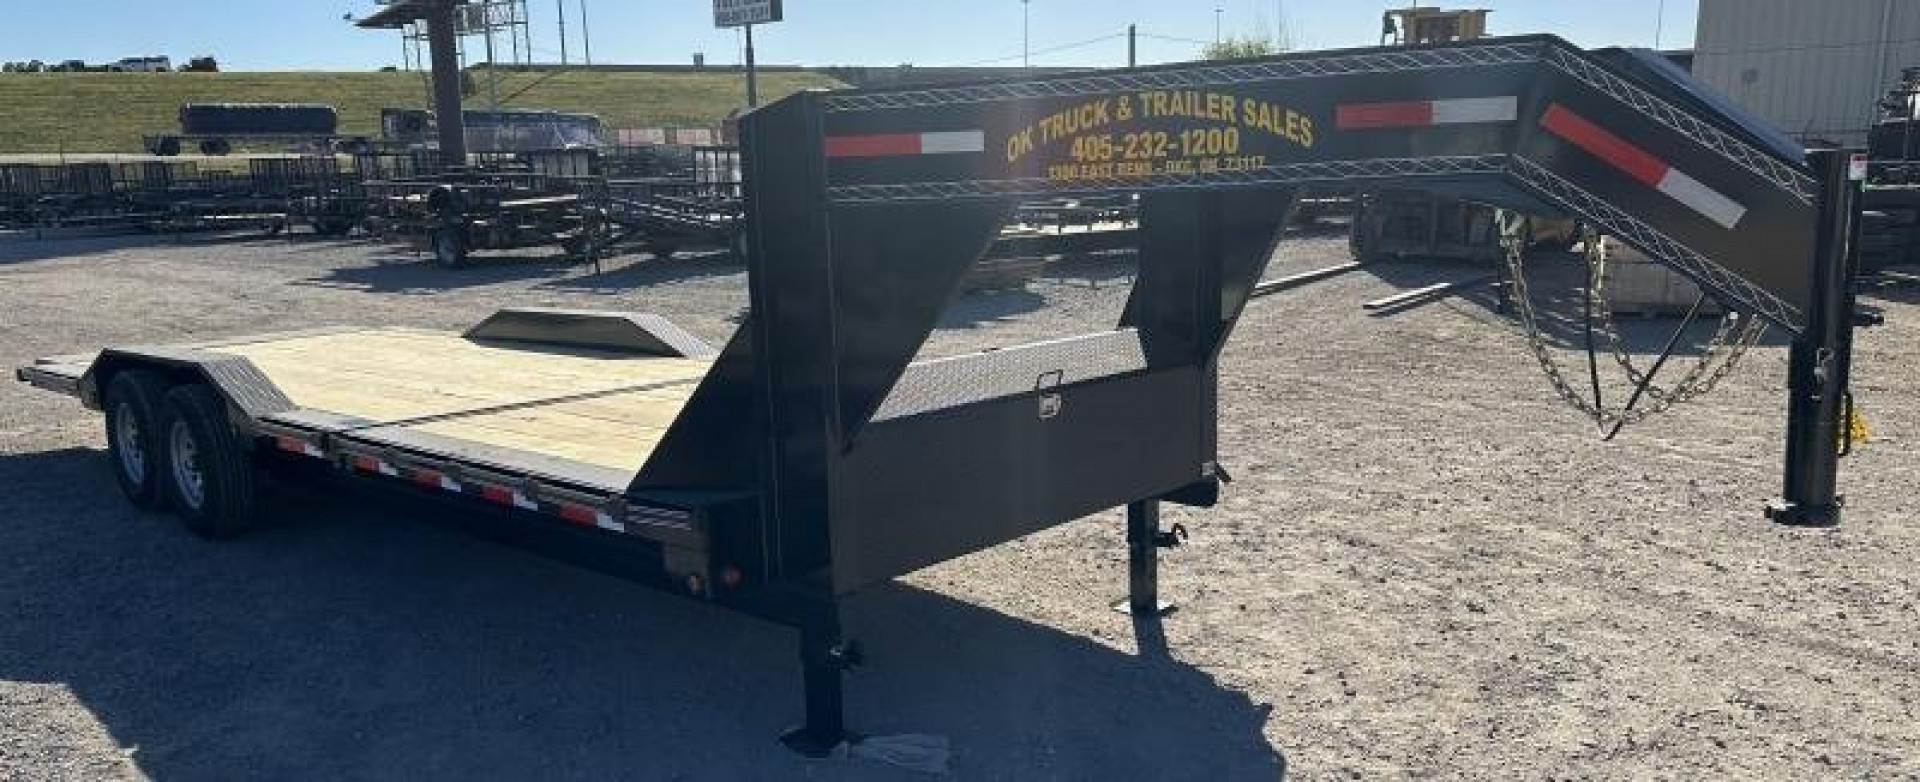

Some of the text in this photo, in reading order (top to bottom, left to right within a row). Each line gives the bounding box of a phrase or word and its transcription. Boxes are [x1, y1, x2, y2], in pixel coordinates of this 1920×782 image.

[1007, 90, 1314, 162] OK TRUCK & TRAILER SALES
[1072, 127, 1239, 162] 405-232-1200
